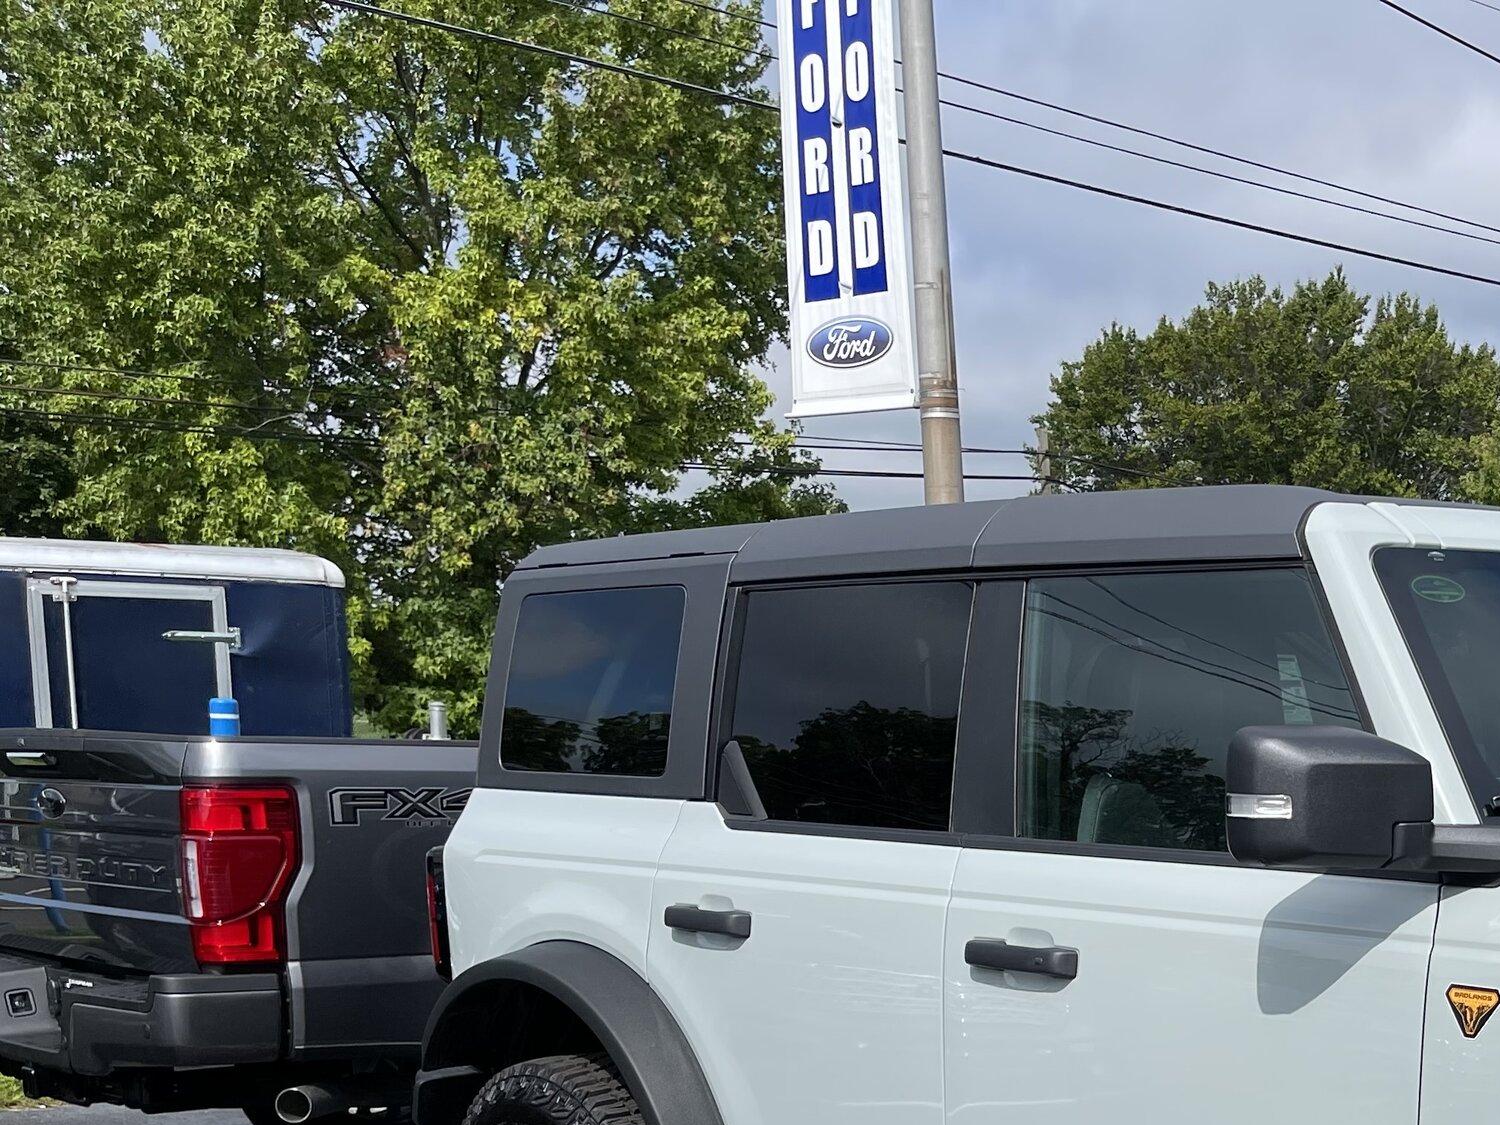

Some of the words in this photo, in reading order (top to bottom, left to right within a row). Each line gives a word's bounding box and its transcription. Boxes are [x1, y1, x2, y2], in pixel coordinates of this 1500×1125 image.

[845, 0, 880, 269] ORD
[822, 324, 876, 361] Ford
[1454, 991, 1493, 1002] BADLANDS
